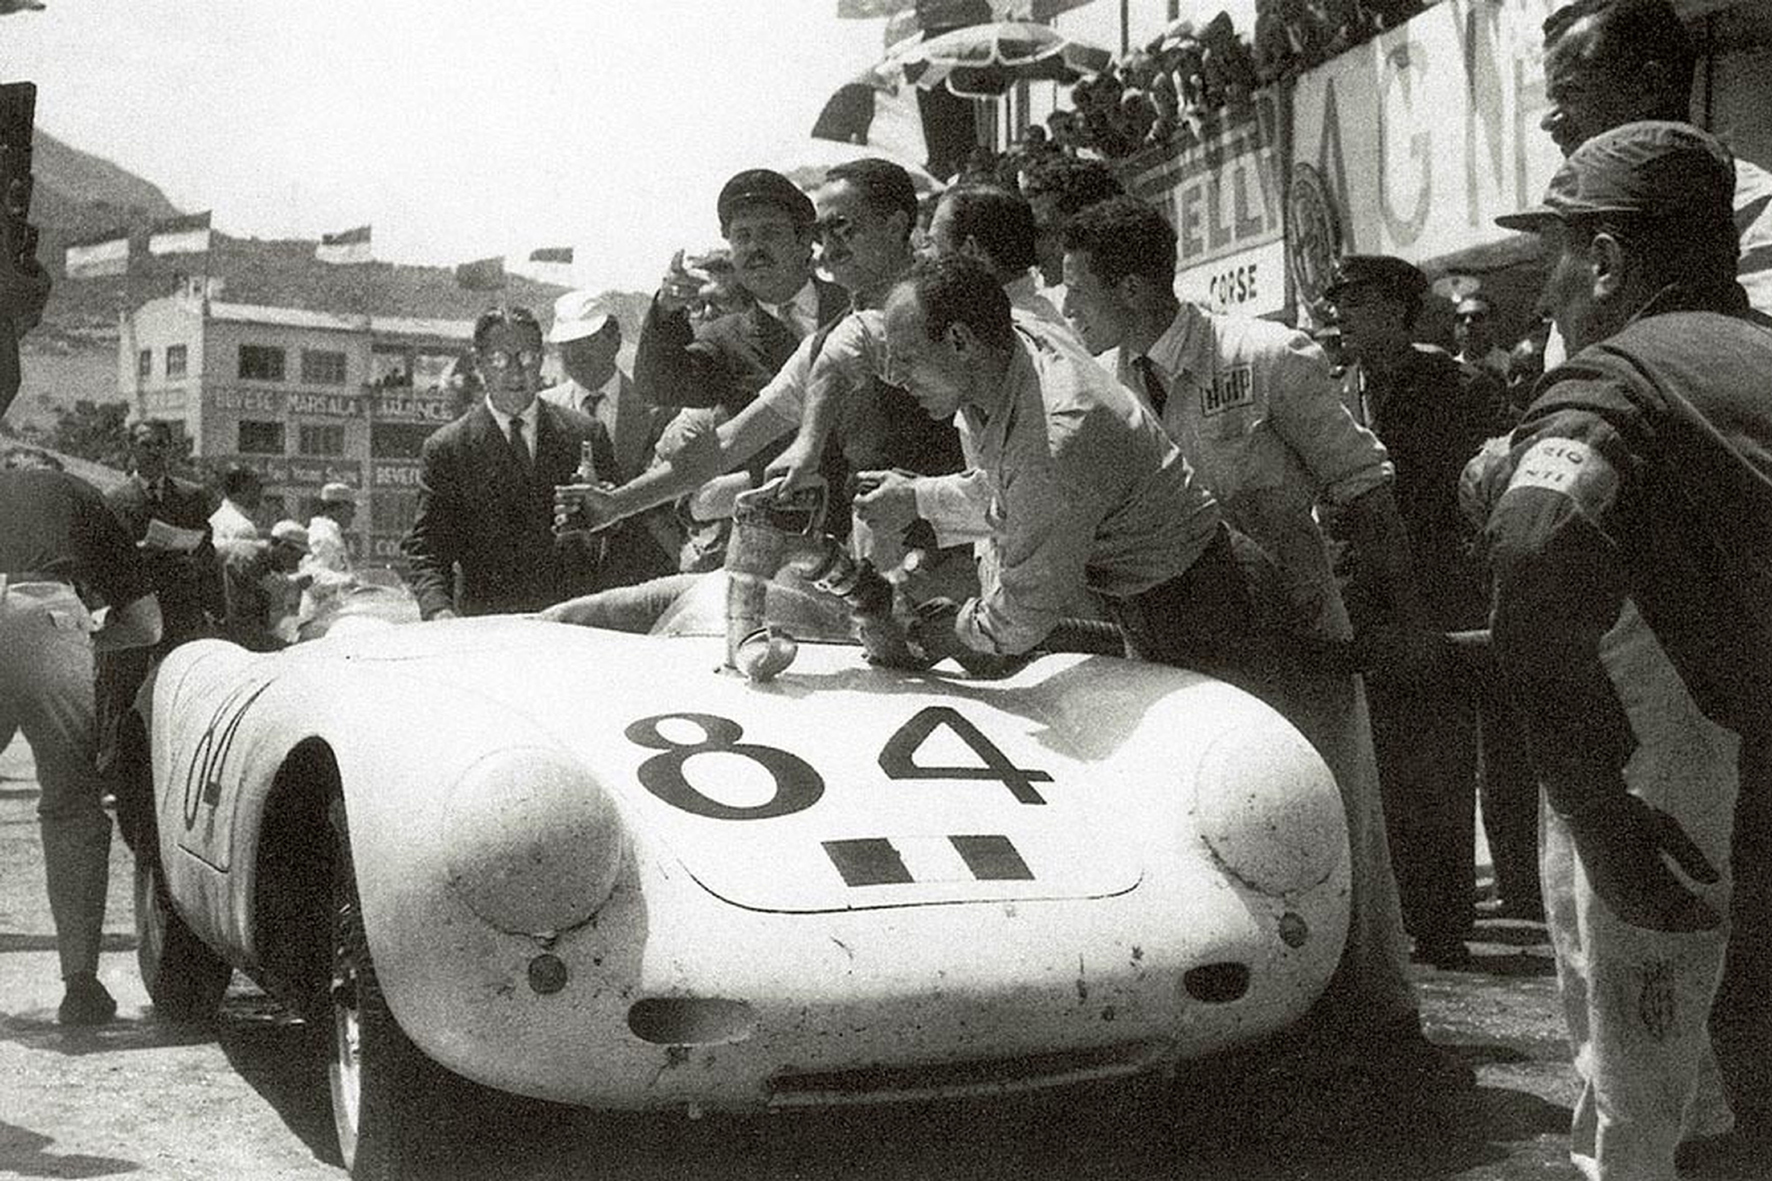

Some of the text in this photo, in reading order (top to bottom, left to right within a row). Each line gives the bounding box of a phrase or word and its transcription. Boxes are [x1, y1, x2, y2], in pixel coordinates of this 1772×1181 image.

[1209, 265, 1257, 304] CORSE
[287, 392, 357, 416] MARSALA
[624, 706, 1055, 820] 84
